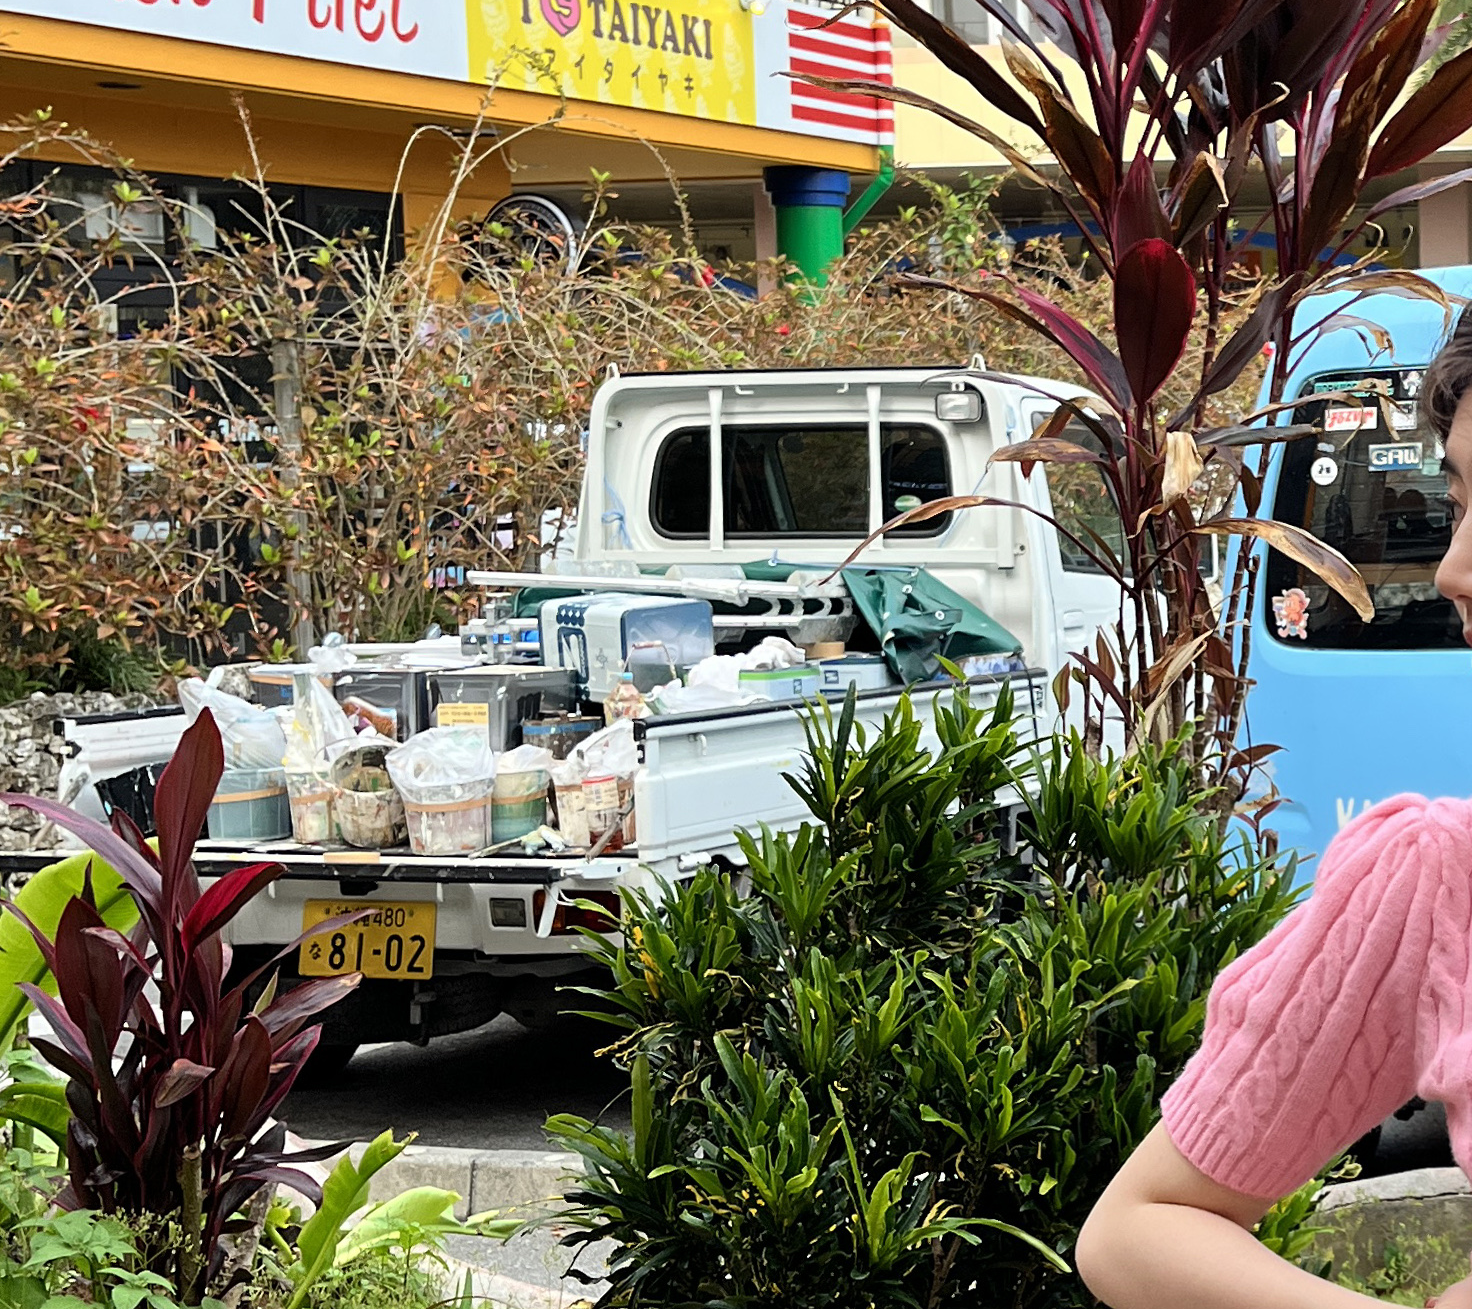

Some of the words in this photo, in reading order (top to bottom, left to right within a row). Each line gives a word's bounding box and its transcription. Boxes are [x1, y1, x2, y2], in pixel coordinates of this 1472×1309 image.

[372, 907, 406, 928] 480
[309, 941, 322, 961] な
[328, 932, 426, 974] 81-02
